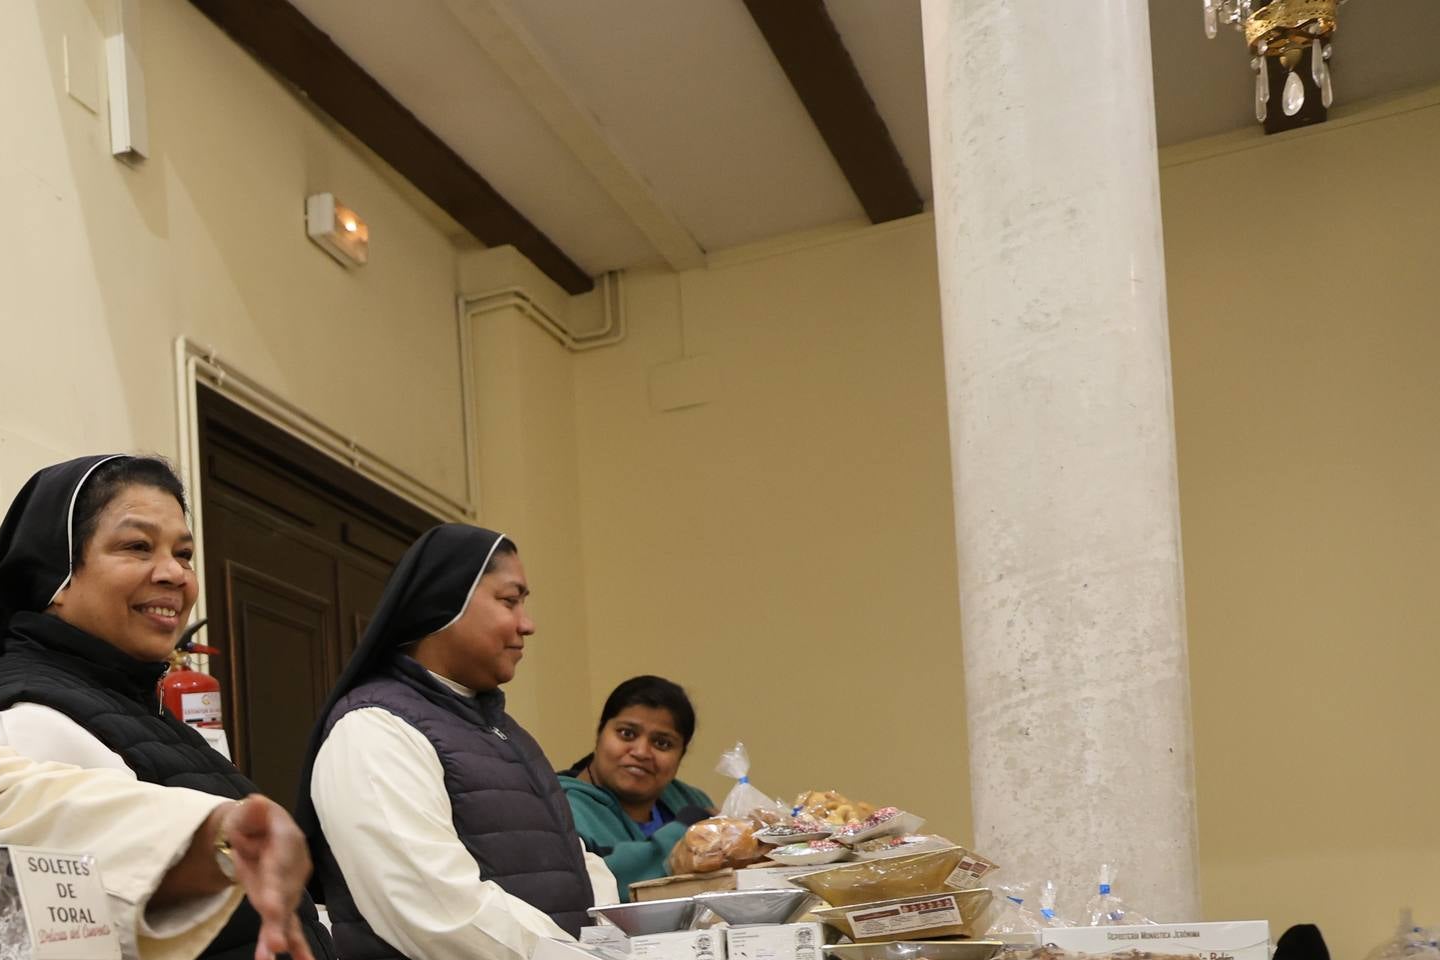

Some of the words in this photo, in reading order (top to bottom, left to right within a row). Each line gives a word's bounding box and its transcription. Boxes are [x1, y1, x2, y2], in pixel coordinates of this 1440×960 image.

[27, 856, 90, 876] SOLETES
[56, 882, 77, 899] DE
[47, 906, 96, 924] TORAL
